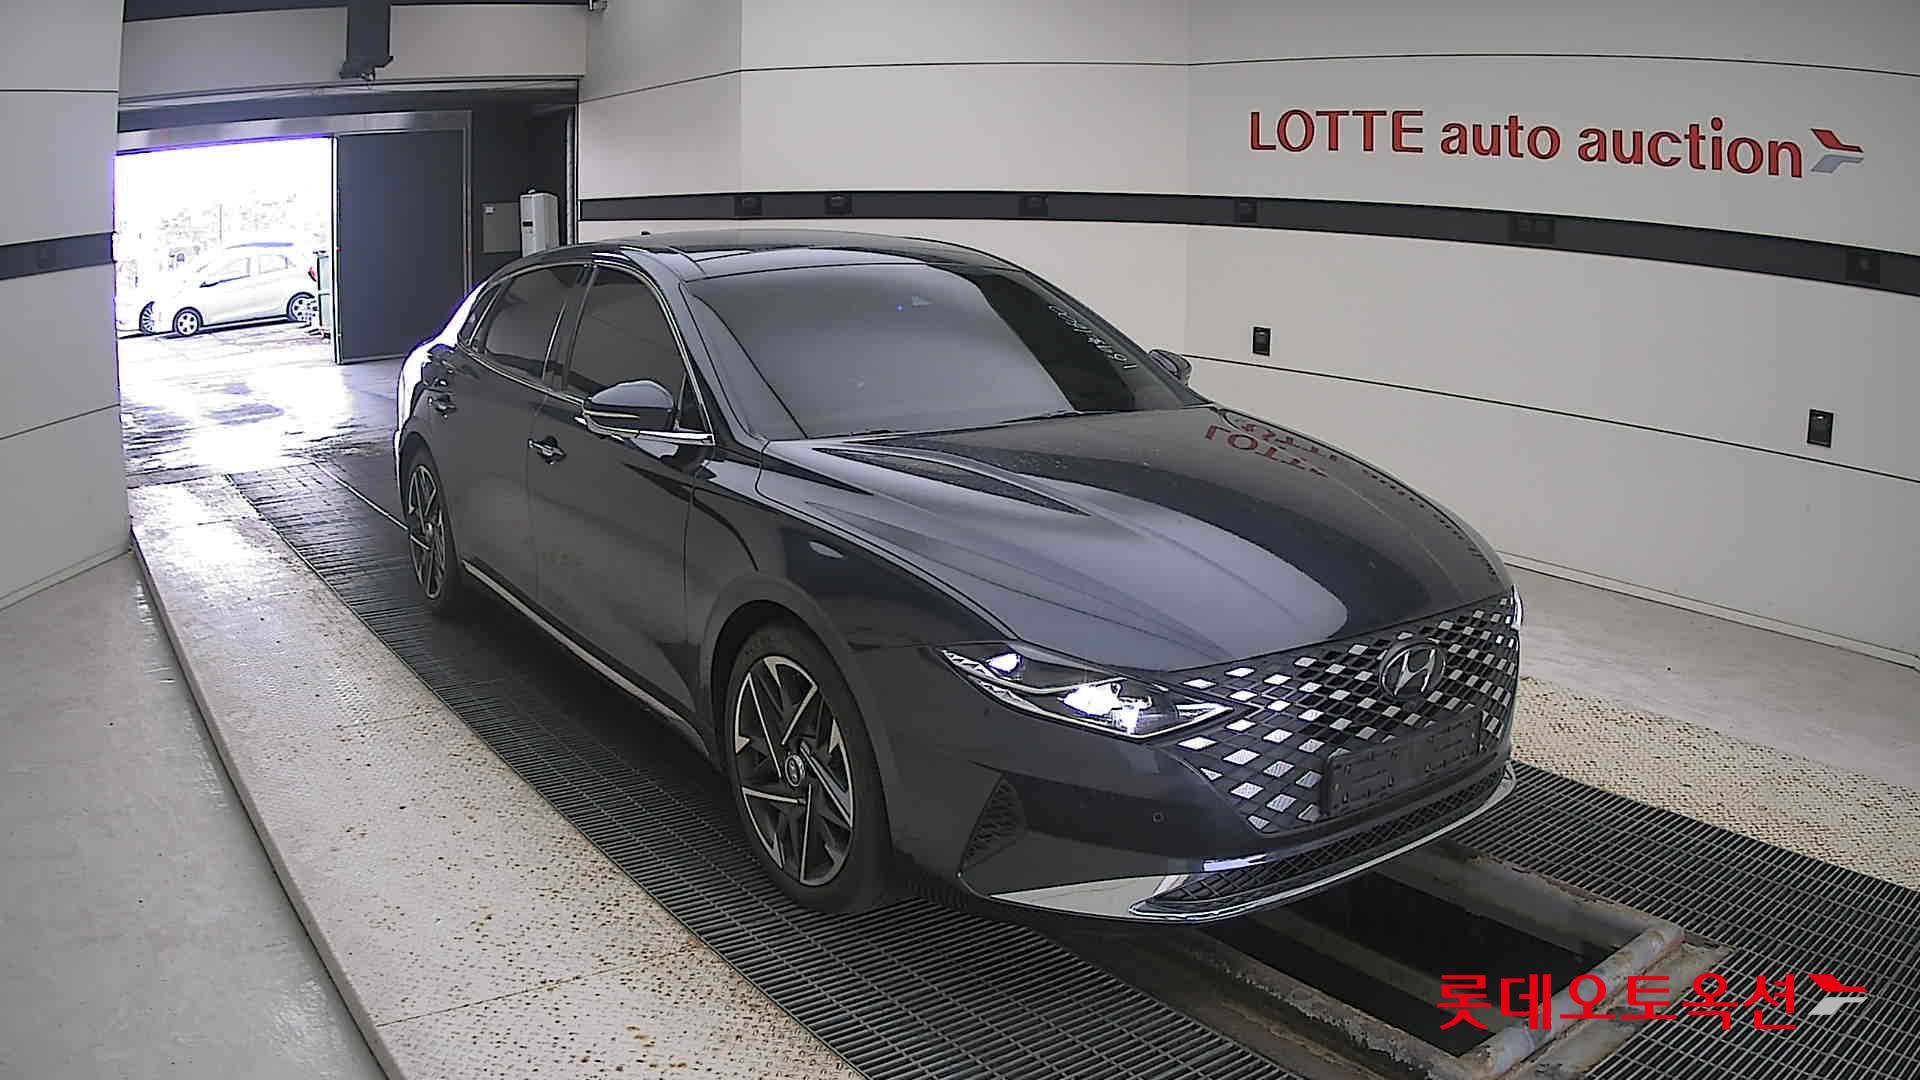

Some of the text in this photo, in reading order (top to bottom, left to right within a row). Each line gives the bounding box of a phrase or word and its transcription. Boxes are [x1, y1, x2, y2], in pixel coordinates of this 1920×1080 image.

[1249, 110, 1803, 178] LOTTE auto auction
